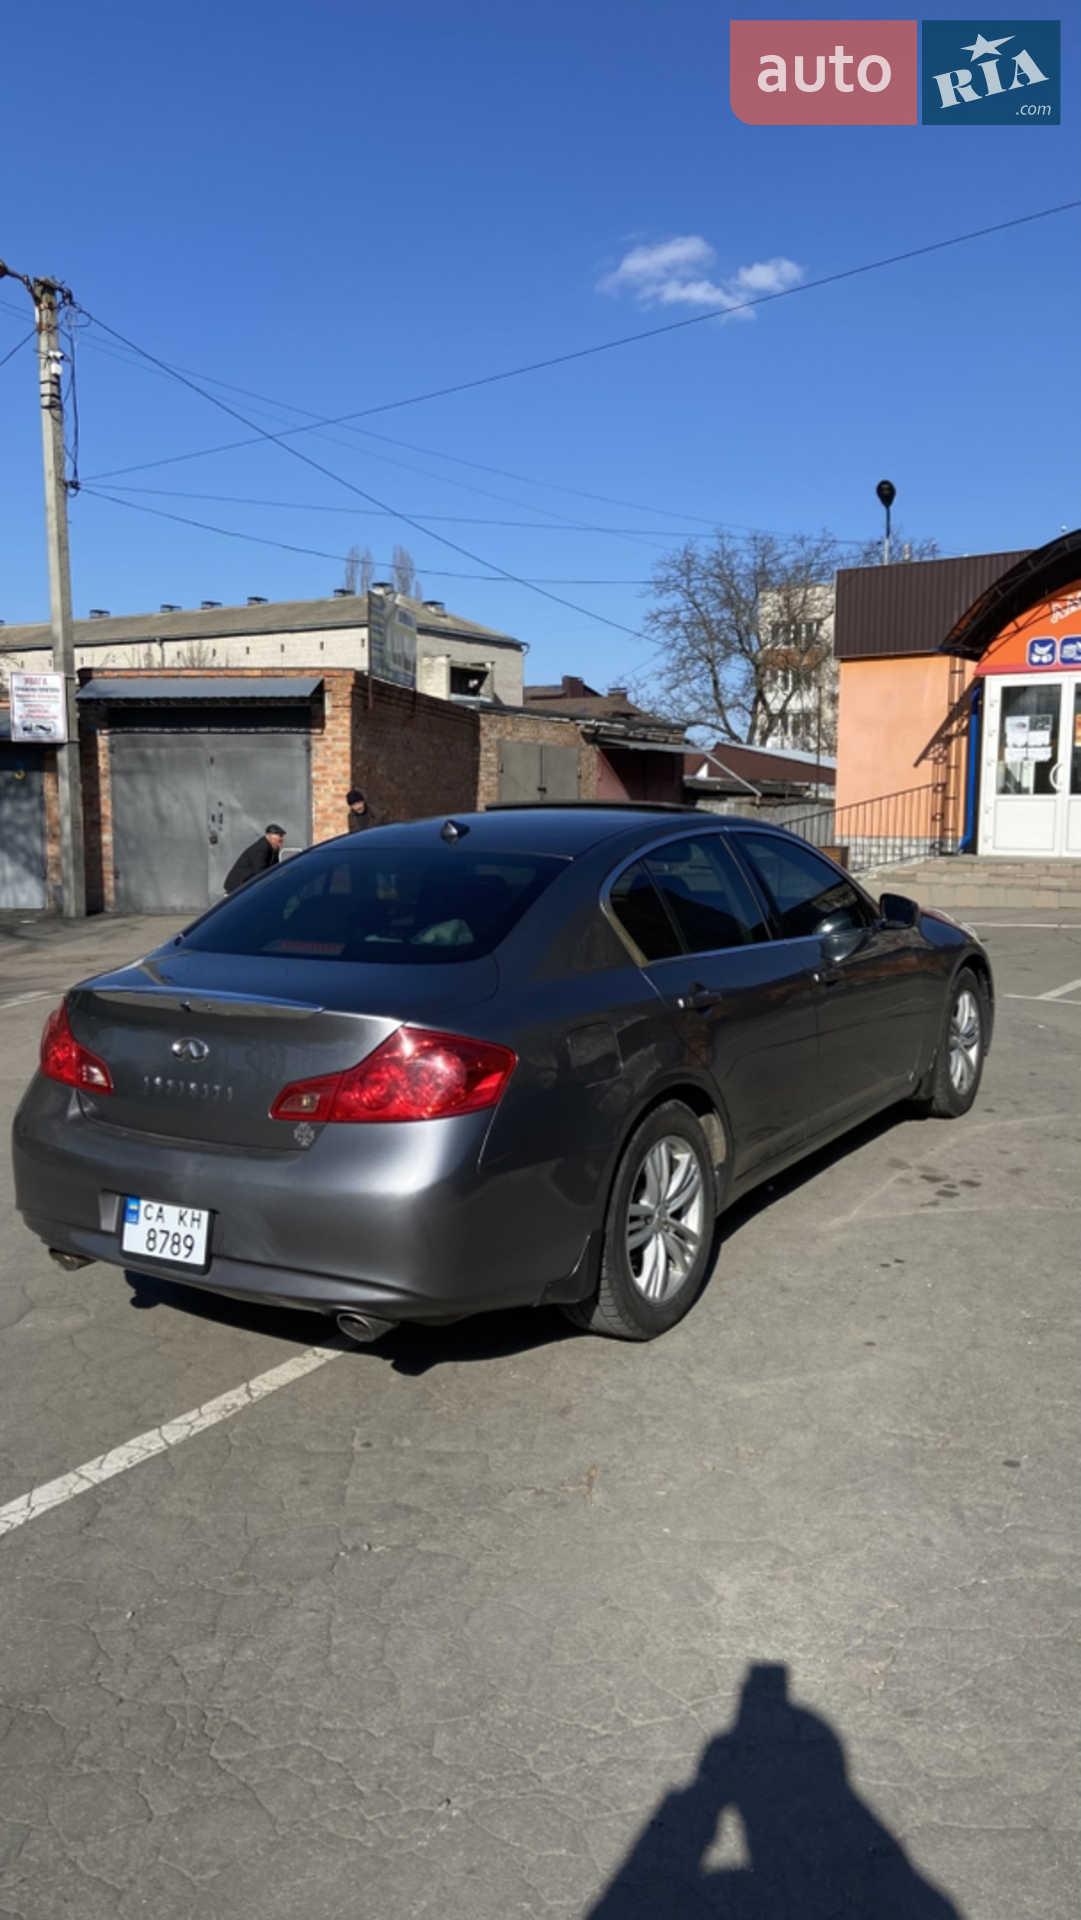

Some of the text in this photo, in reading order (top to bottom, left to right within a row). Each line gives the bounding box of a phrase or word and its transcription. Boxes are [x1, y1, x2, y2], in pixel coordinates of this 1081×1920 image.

[143, 1203, 166, 1224] CA
[178, 1208, 202, 1229] KH
[145, 1227, 195, 1259] 8789
